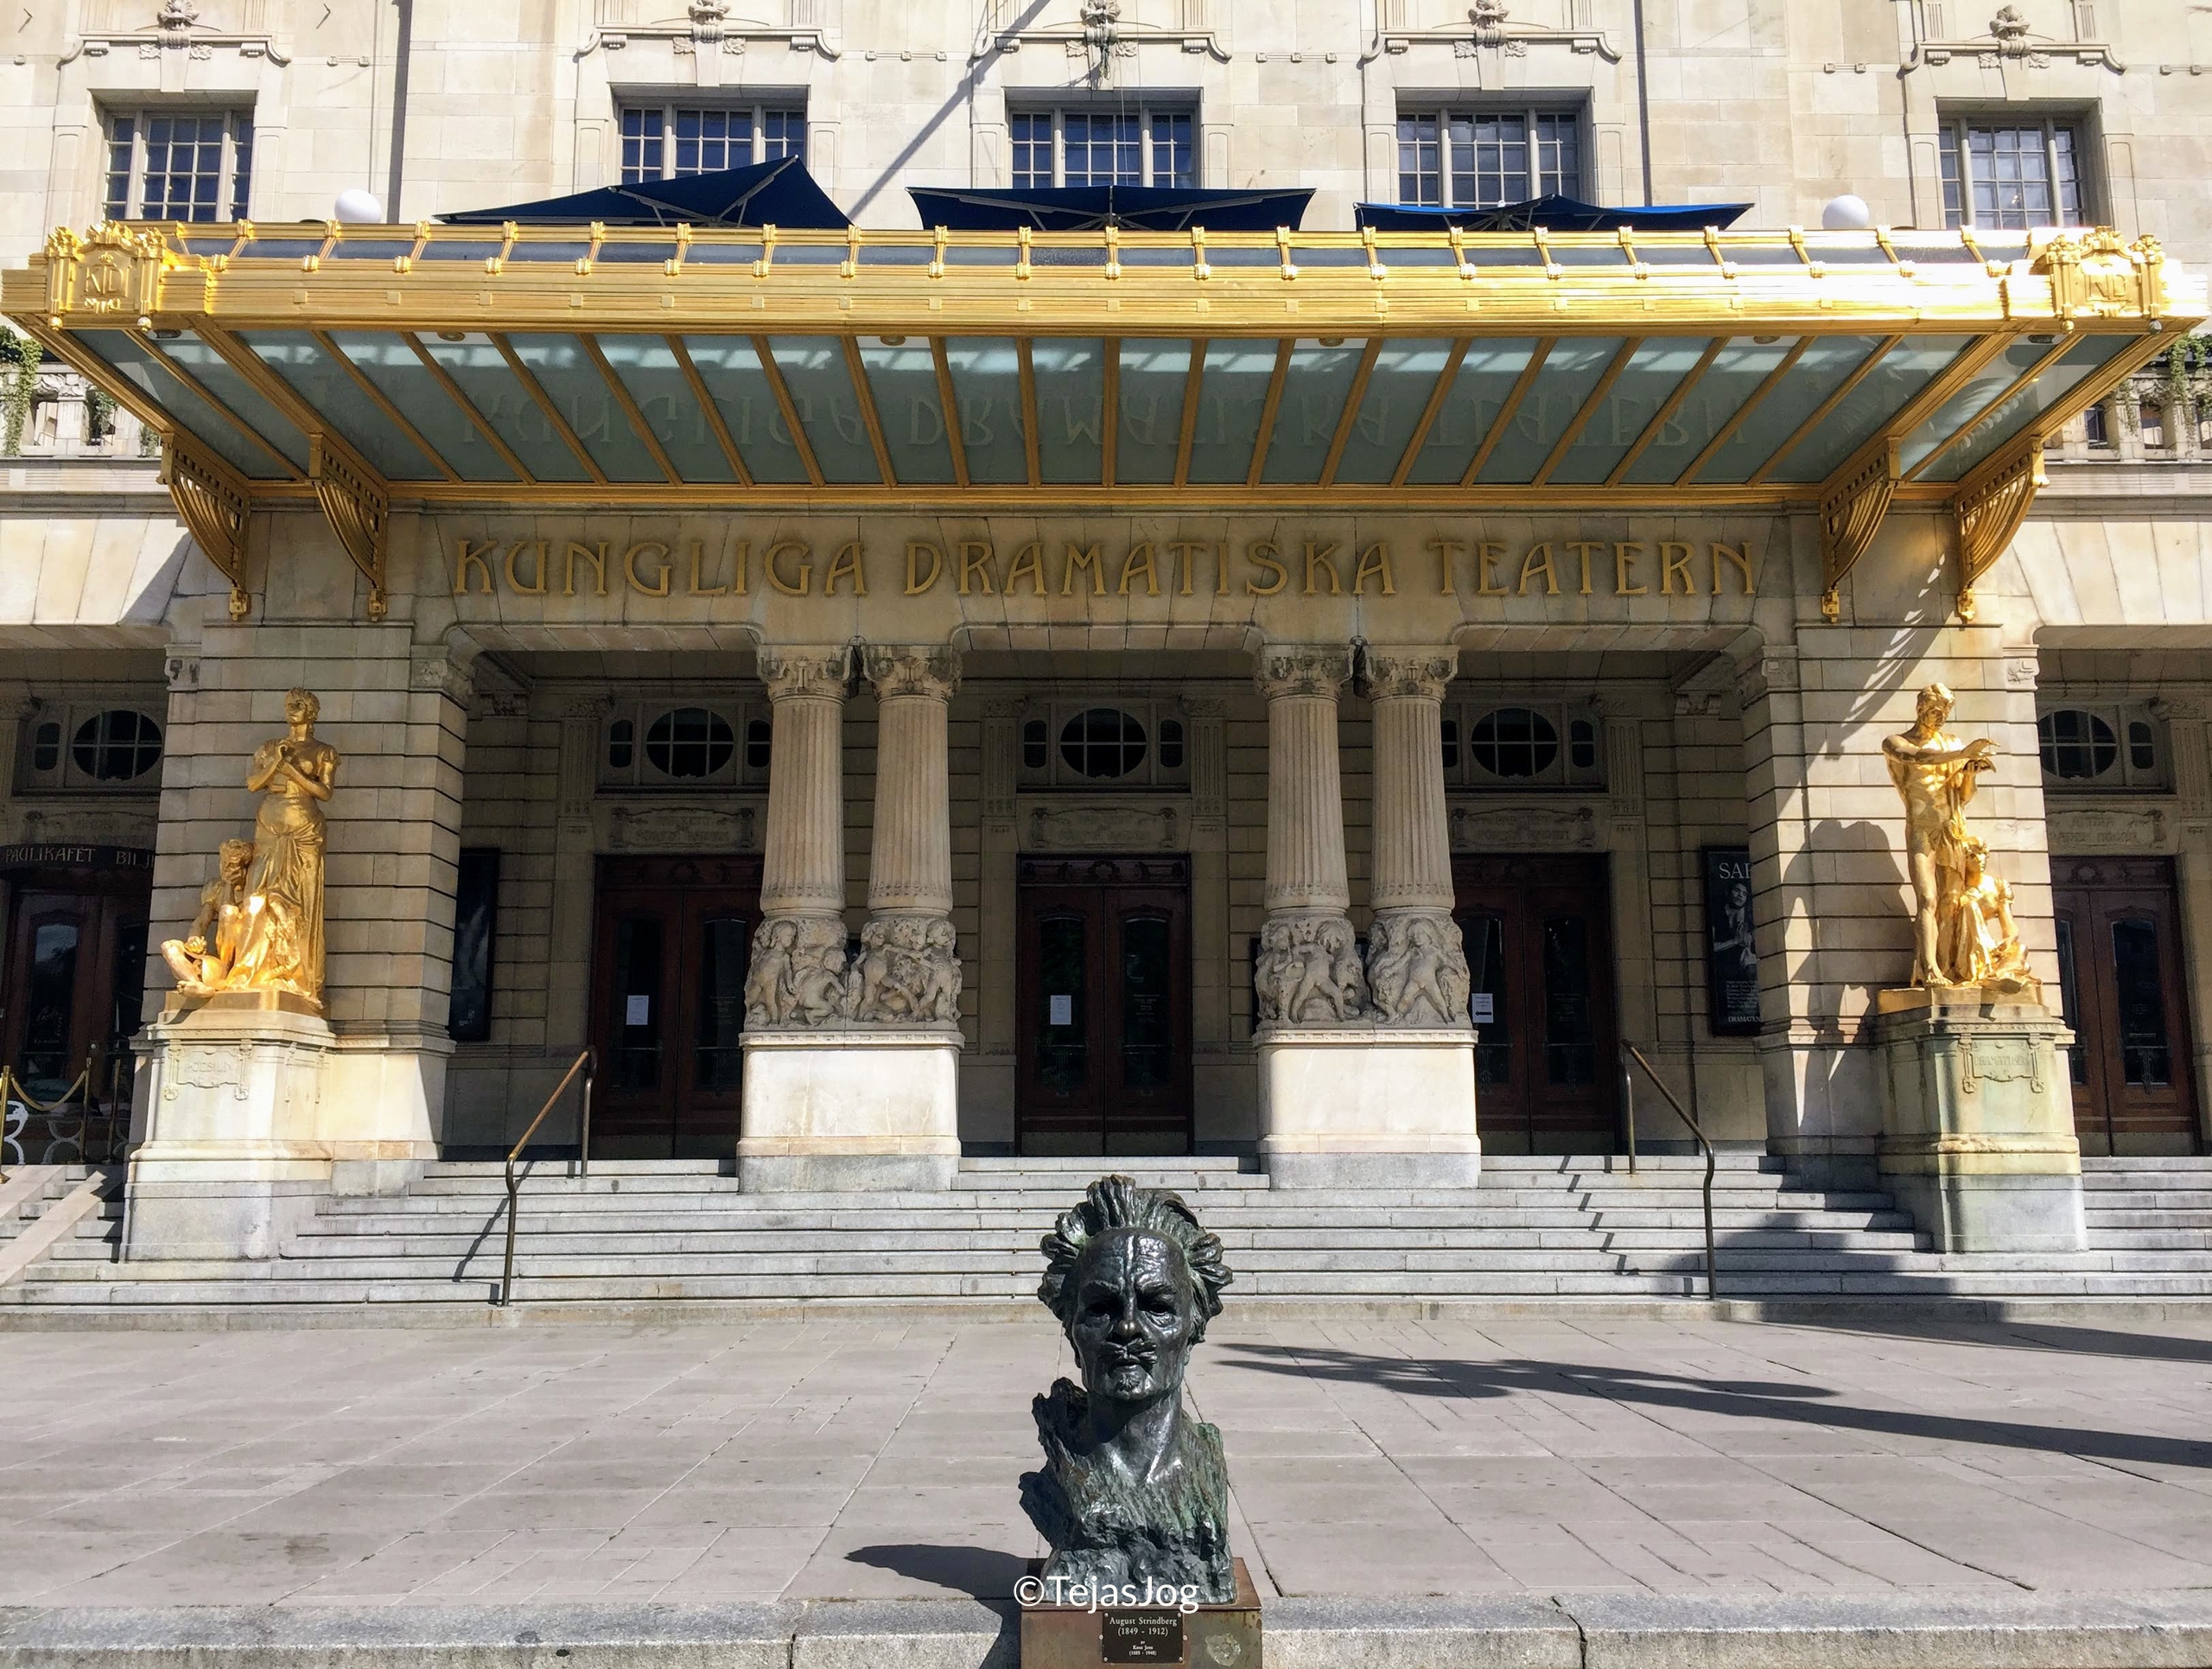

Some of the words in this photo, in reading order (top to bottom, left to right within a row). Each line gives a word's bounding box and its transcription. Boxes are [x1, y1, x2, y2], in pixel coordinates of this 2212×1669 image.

[453, 538, 868, 598] KUNGLIGA
[904, 539, 1396, 596] DRAMATISKA
[1427, 539, 1756, 596] TEATERN
[1109, 1616, 1135, 1627] August
[1138, 1616, 1178, 1627] Strindberg
[1117, 1627, 1139, 1636] (1849
[1148, 1627, 1168, 1636] 1912)
